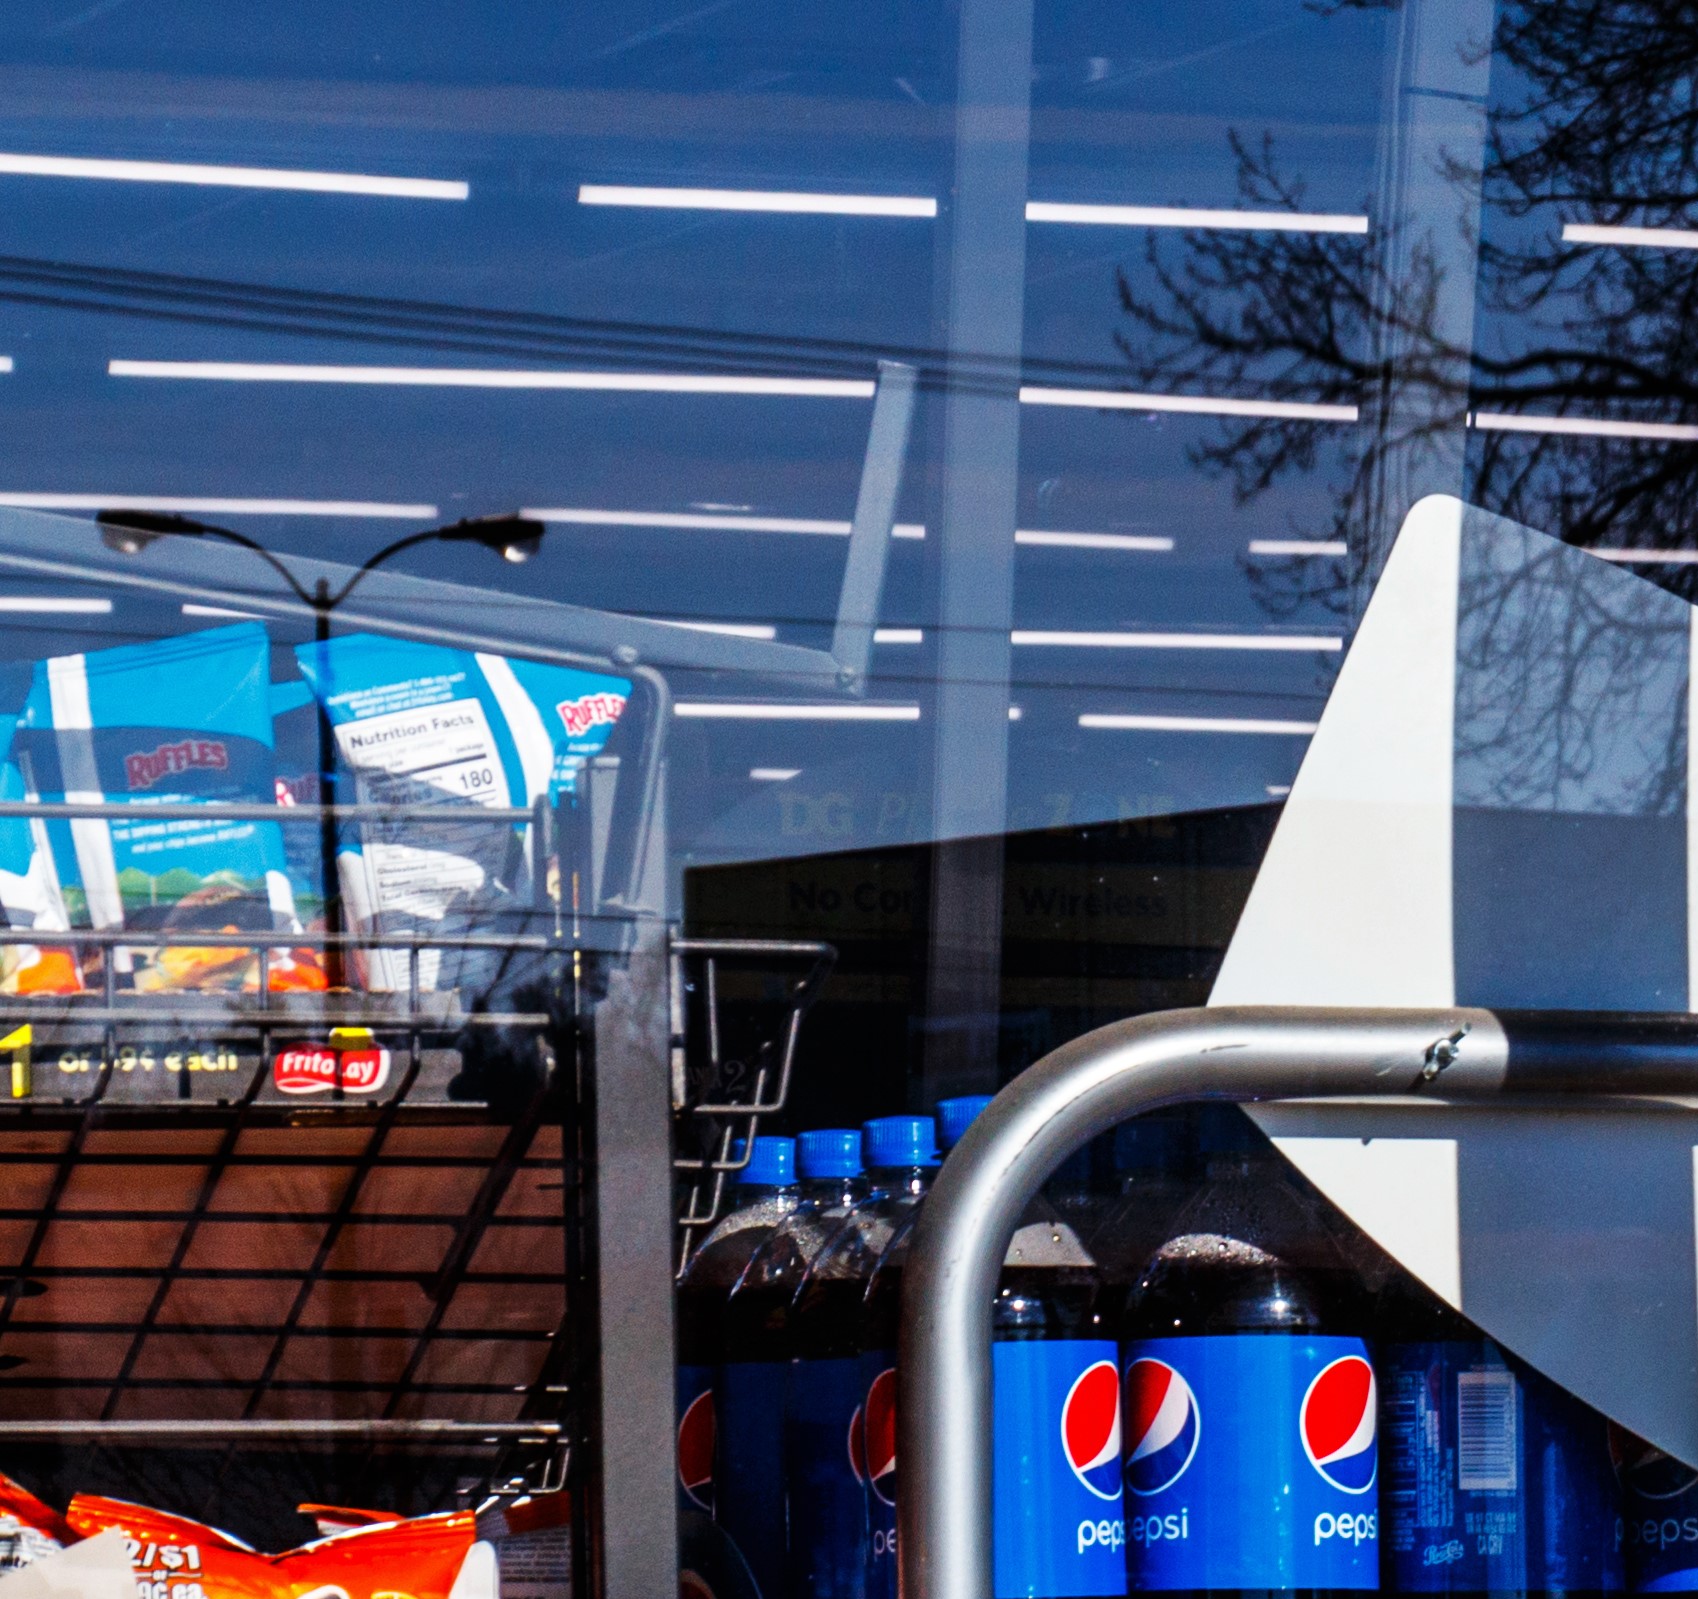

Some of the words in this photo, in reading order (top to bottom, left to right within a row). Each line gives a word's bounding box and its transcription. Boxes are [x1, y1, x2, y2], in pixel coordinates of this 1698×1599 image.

[350, 724, 427, 750] Nutrition
[431, 714, 475, 732] Facts
[126, 740, 228, 789] RUFFLES
[458, 769, 494, 790] 180
